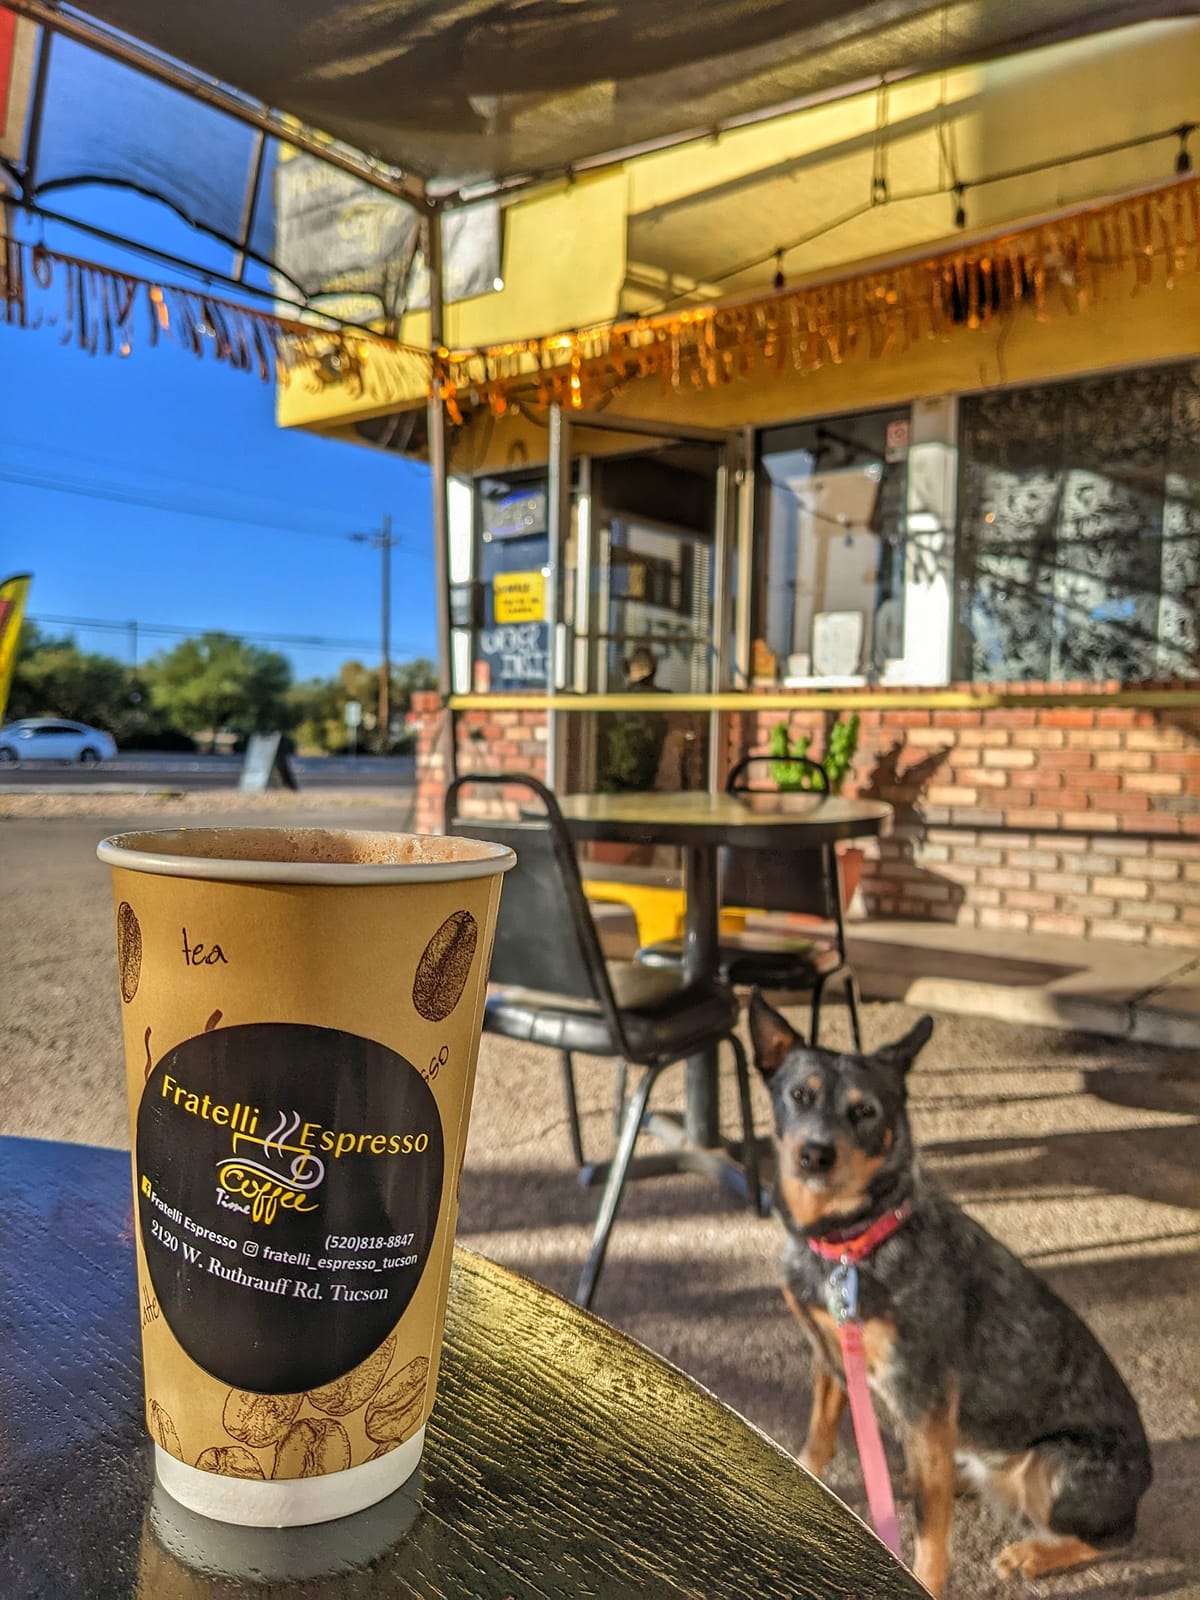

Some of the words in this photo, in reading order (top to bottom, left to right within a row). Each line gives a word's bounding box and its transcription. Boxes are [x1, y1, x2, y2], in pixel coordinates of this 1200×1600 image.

[182, 927, 229, 966] tea
[161, 1074, 260, 1135] Fratelli
[299, 1122, 430, 1159] Espresso
[215, 1186, 251, 1215] Time
[219, 1163, 320, 1226] Coffee
[151, 1191, 184, 1225] Fratelli
[183, 1216, 238, 1250] Espresso
[324, 1232, 415, 1252] (520)818-8847
[151, 1219, 179, 1252] 2120
[182, 1241, 204, 1269] W.
[207, 1256, 292, 1296] Ruthrauff
[293, 1280, 323, 1300] Rd.
[329, 1283, 389, 1301] Tucson
[262, 1246, 418, 1272] fratelli_espresso_tucson
[142, 1284, 160, 1330] atte
